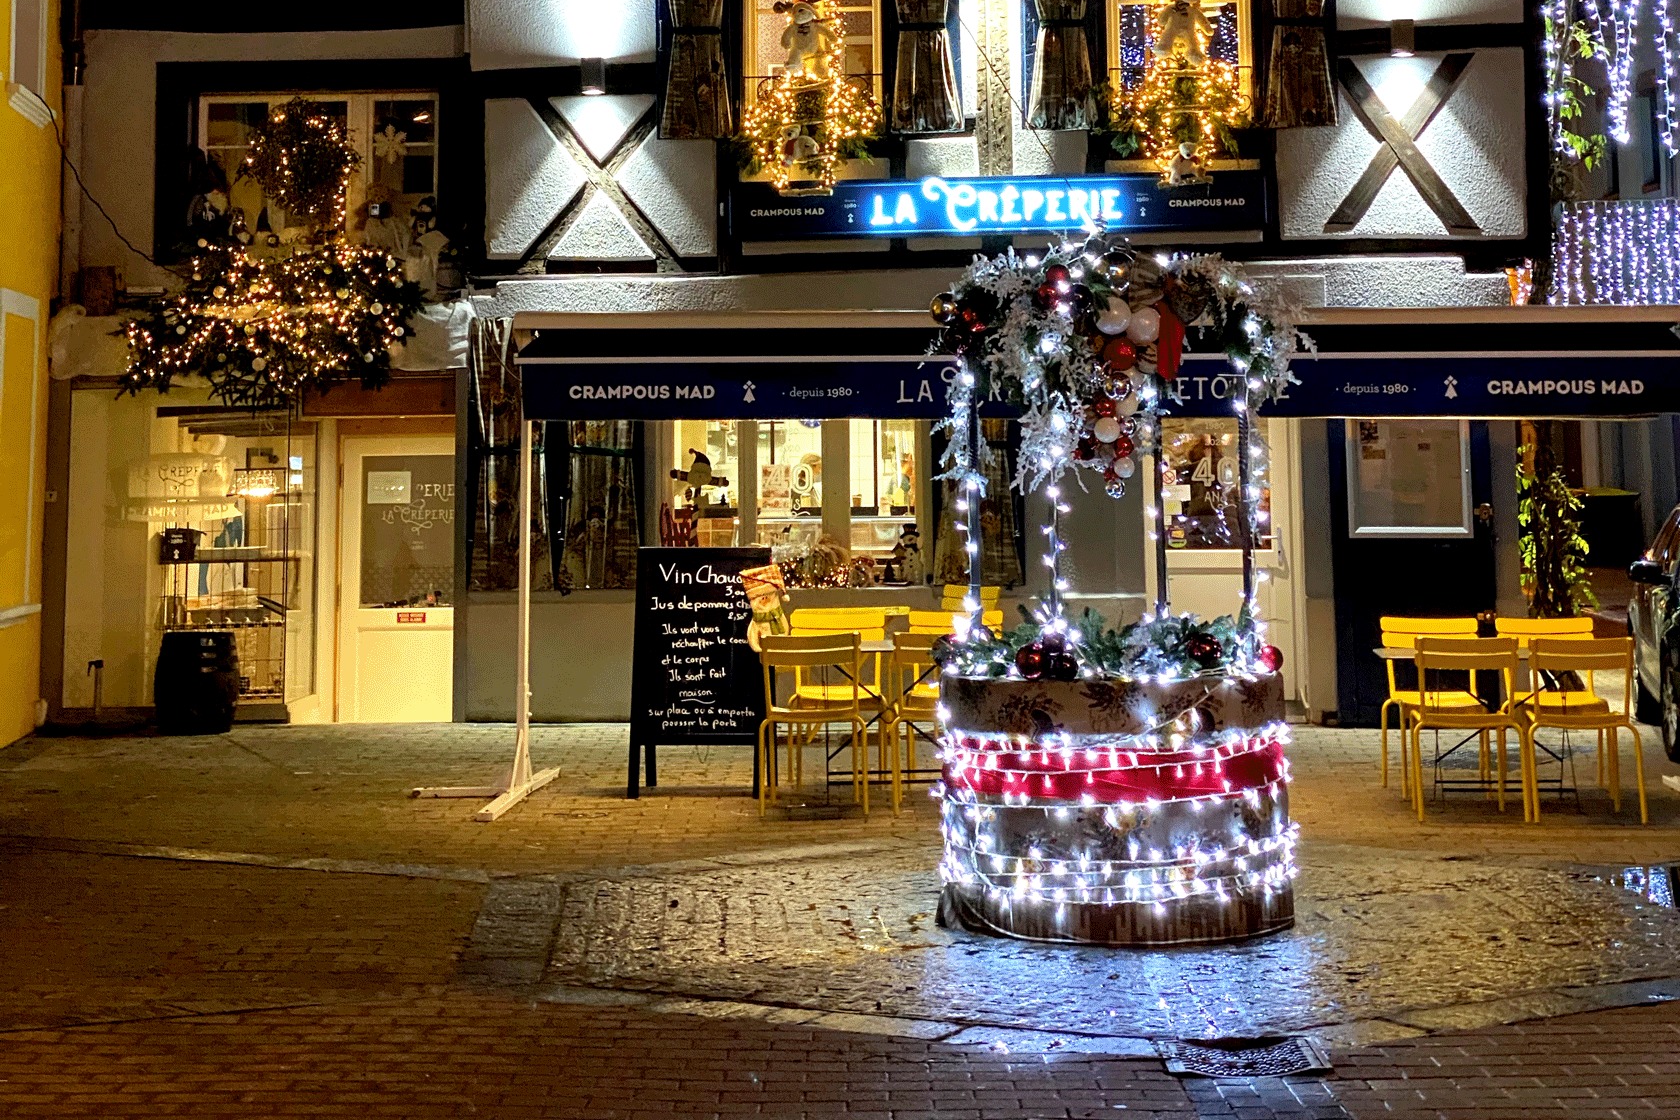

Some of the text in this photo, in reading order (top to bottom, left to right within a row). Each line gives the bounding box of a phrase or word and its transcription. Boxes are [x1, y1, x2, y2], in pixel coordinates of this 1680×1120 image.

[870, 177, 1123, 232] LA CRÊPERIE
[1169, 198, 1246, 208] CRAMPOUS MAD
[750, 207, 825, 217] CRAMPOUS MAD
[569, 385, 716, 400] CRAMPOUS MAD
[789, 386, 852, 399] depuis 1980
[896, 380, 933, 403] LA
[1343, 382, 1409, 395] depuis 1980
[1487, 380, 1644, 395] CRAMPOUS MAD
[659, 563, 692, 584] Vin
[650, 596, 675, 610] Jus
[678, 595, 693, 609] de
[680, 621, 699, 634] vont
[700, 626, 720, 634] vous
[716, 636, 726, 645] le
[661, 654, 709, 665] et le corps
[684, 669, 706, 681] sont
[709, 667, 726, 678] fait
[648, 708, 664, 716] sur
[666, 703, 691, 717] place
[699, 717, 709, 726] la
[712, 718, 737, 729] porte
